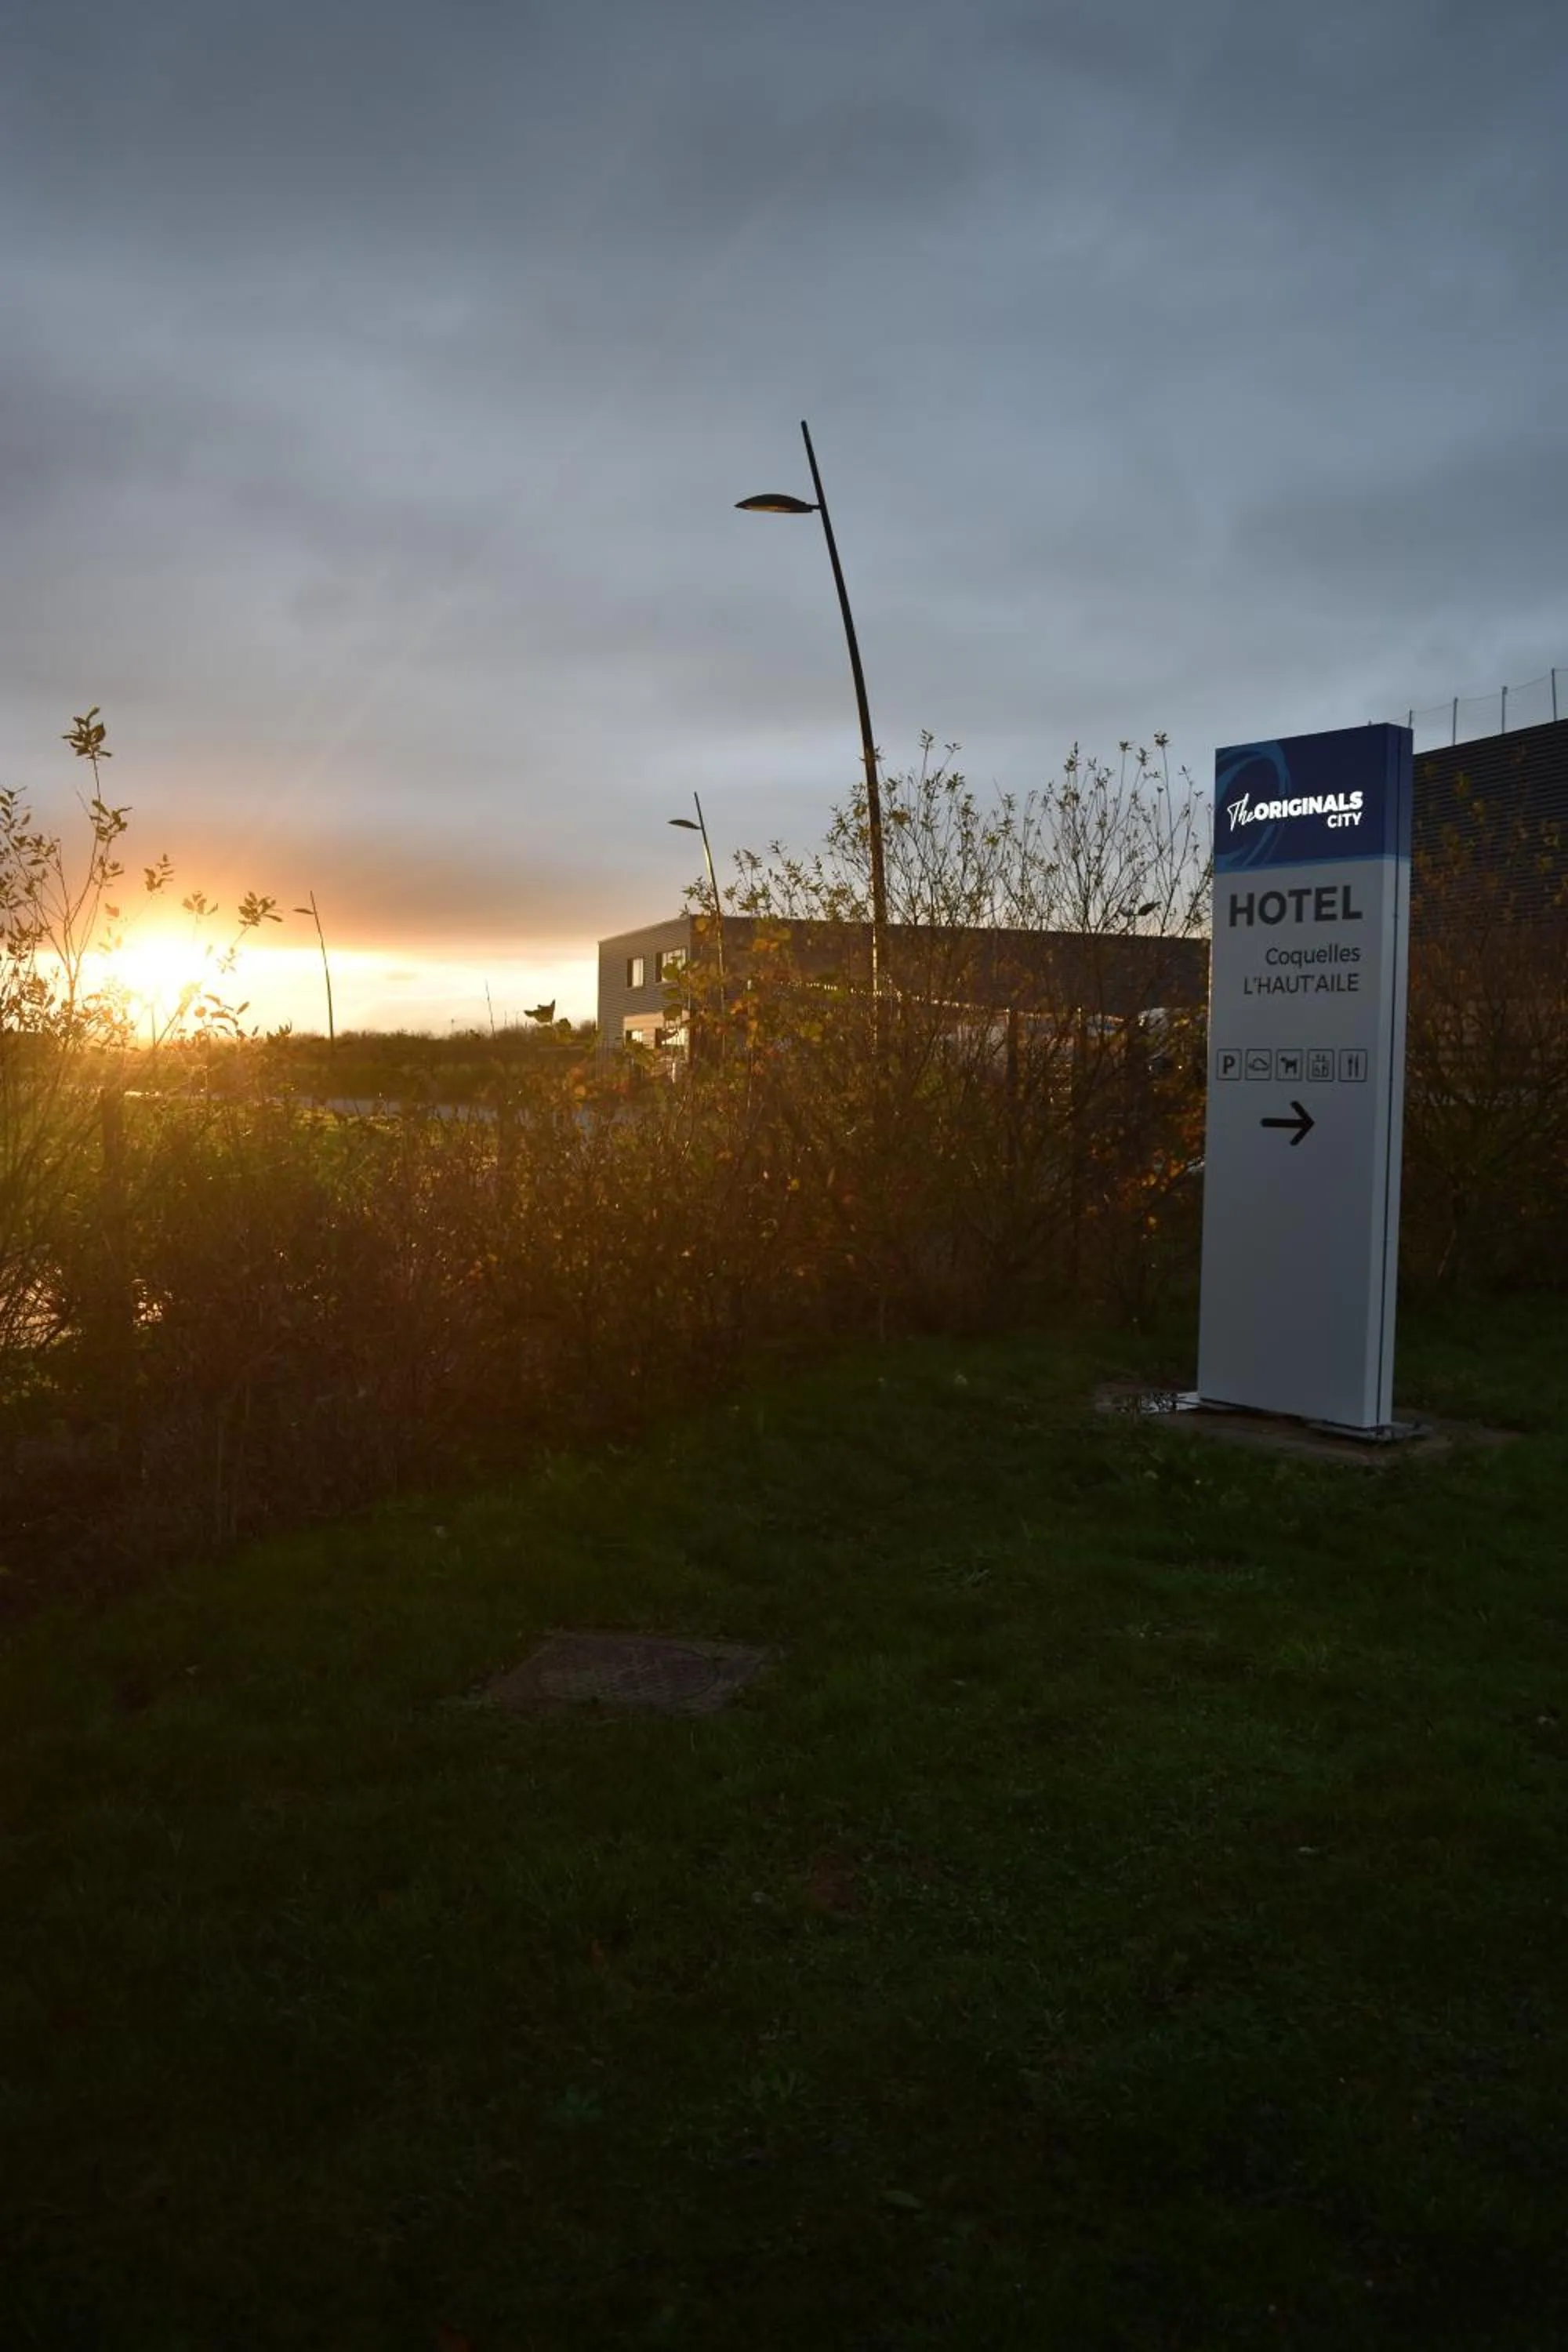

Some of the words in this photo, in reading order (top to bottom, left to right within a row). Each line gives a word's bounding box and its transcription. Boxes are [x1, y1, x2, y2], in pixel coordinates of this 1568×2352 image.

[1254, 790, 1363, 821] ORIGINALS
[1327, 811, 1363, 829] CITY
[1229, 884, 1363, 927] HOTEL
[1265, 943, 1361, 968] Coquelles
[1222, 1055, 1236, 1075] P
